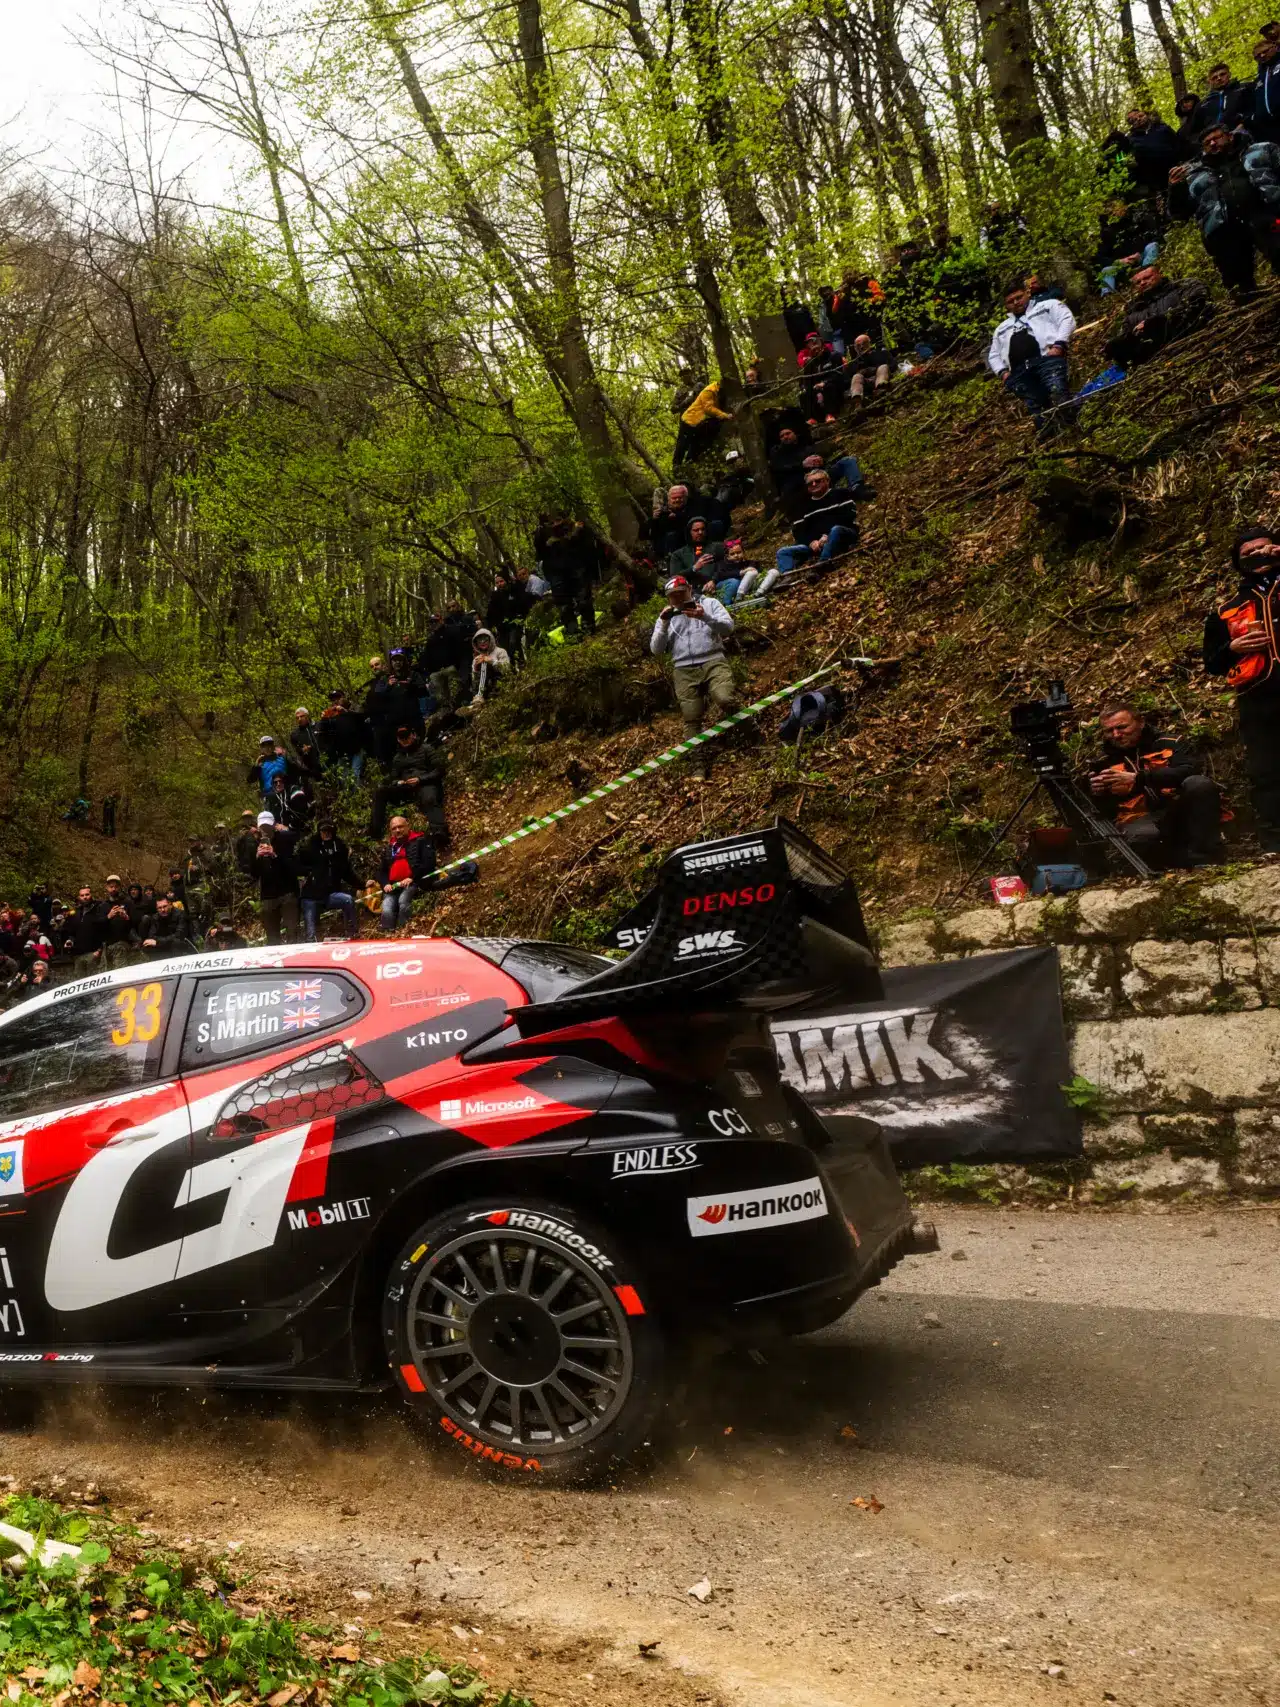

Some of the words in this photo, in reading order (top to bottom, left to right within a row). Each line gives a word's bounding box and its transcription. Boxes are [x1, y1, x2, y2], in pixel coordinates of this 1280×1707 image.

[683, 845, 766, 870] SCHROTH
[685, 857, 768, 877] RACING
[683, 884, 776, 915] DENSO
[617, 919, 655, 948] St
[678, 931, 736, 956] SWS
[53, 975, 113, 999] PROTERIAL
[111, 982, 163, 1046] 33
[206, 988, 281, 1015] E.Evans
[197, 1015, 279, 1043] S.Martin
[465, 1096, 537, 1116] Microsoft
[613, 1143, 698, 1173] ENDLESS
[287, 1202, 347, 1231] Mobil
[43, 1352, 94, 1363] Racing
